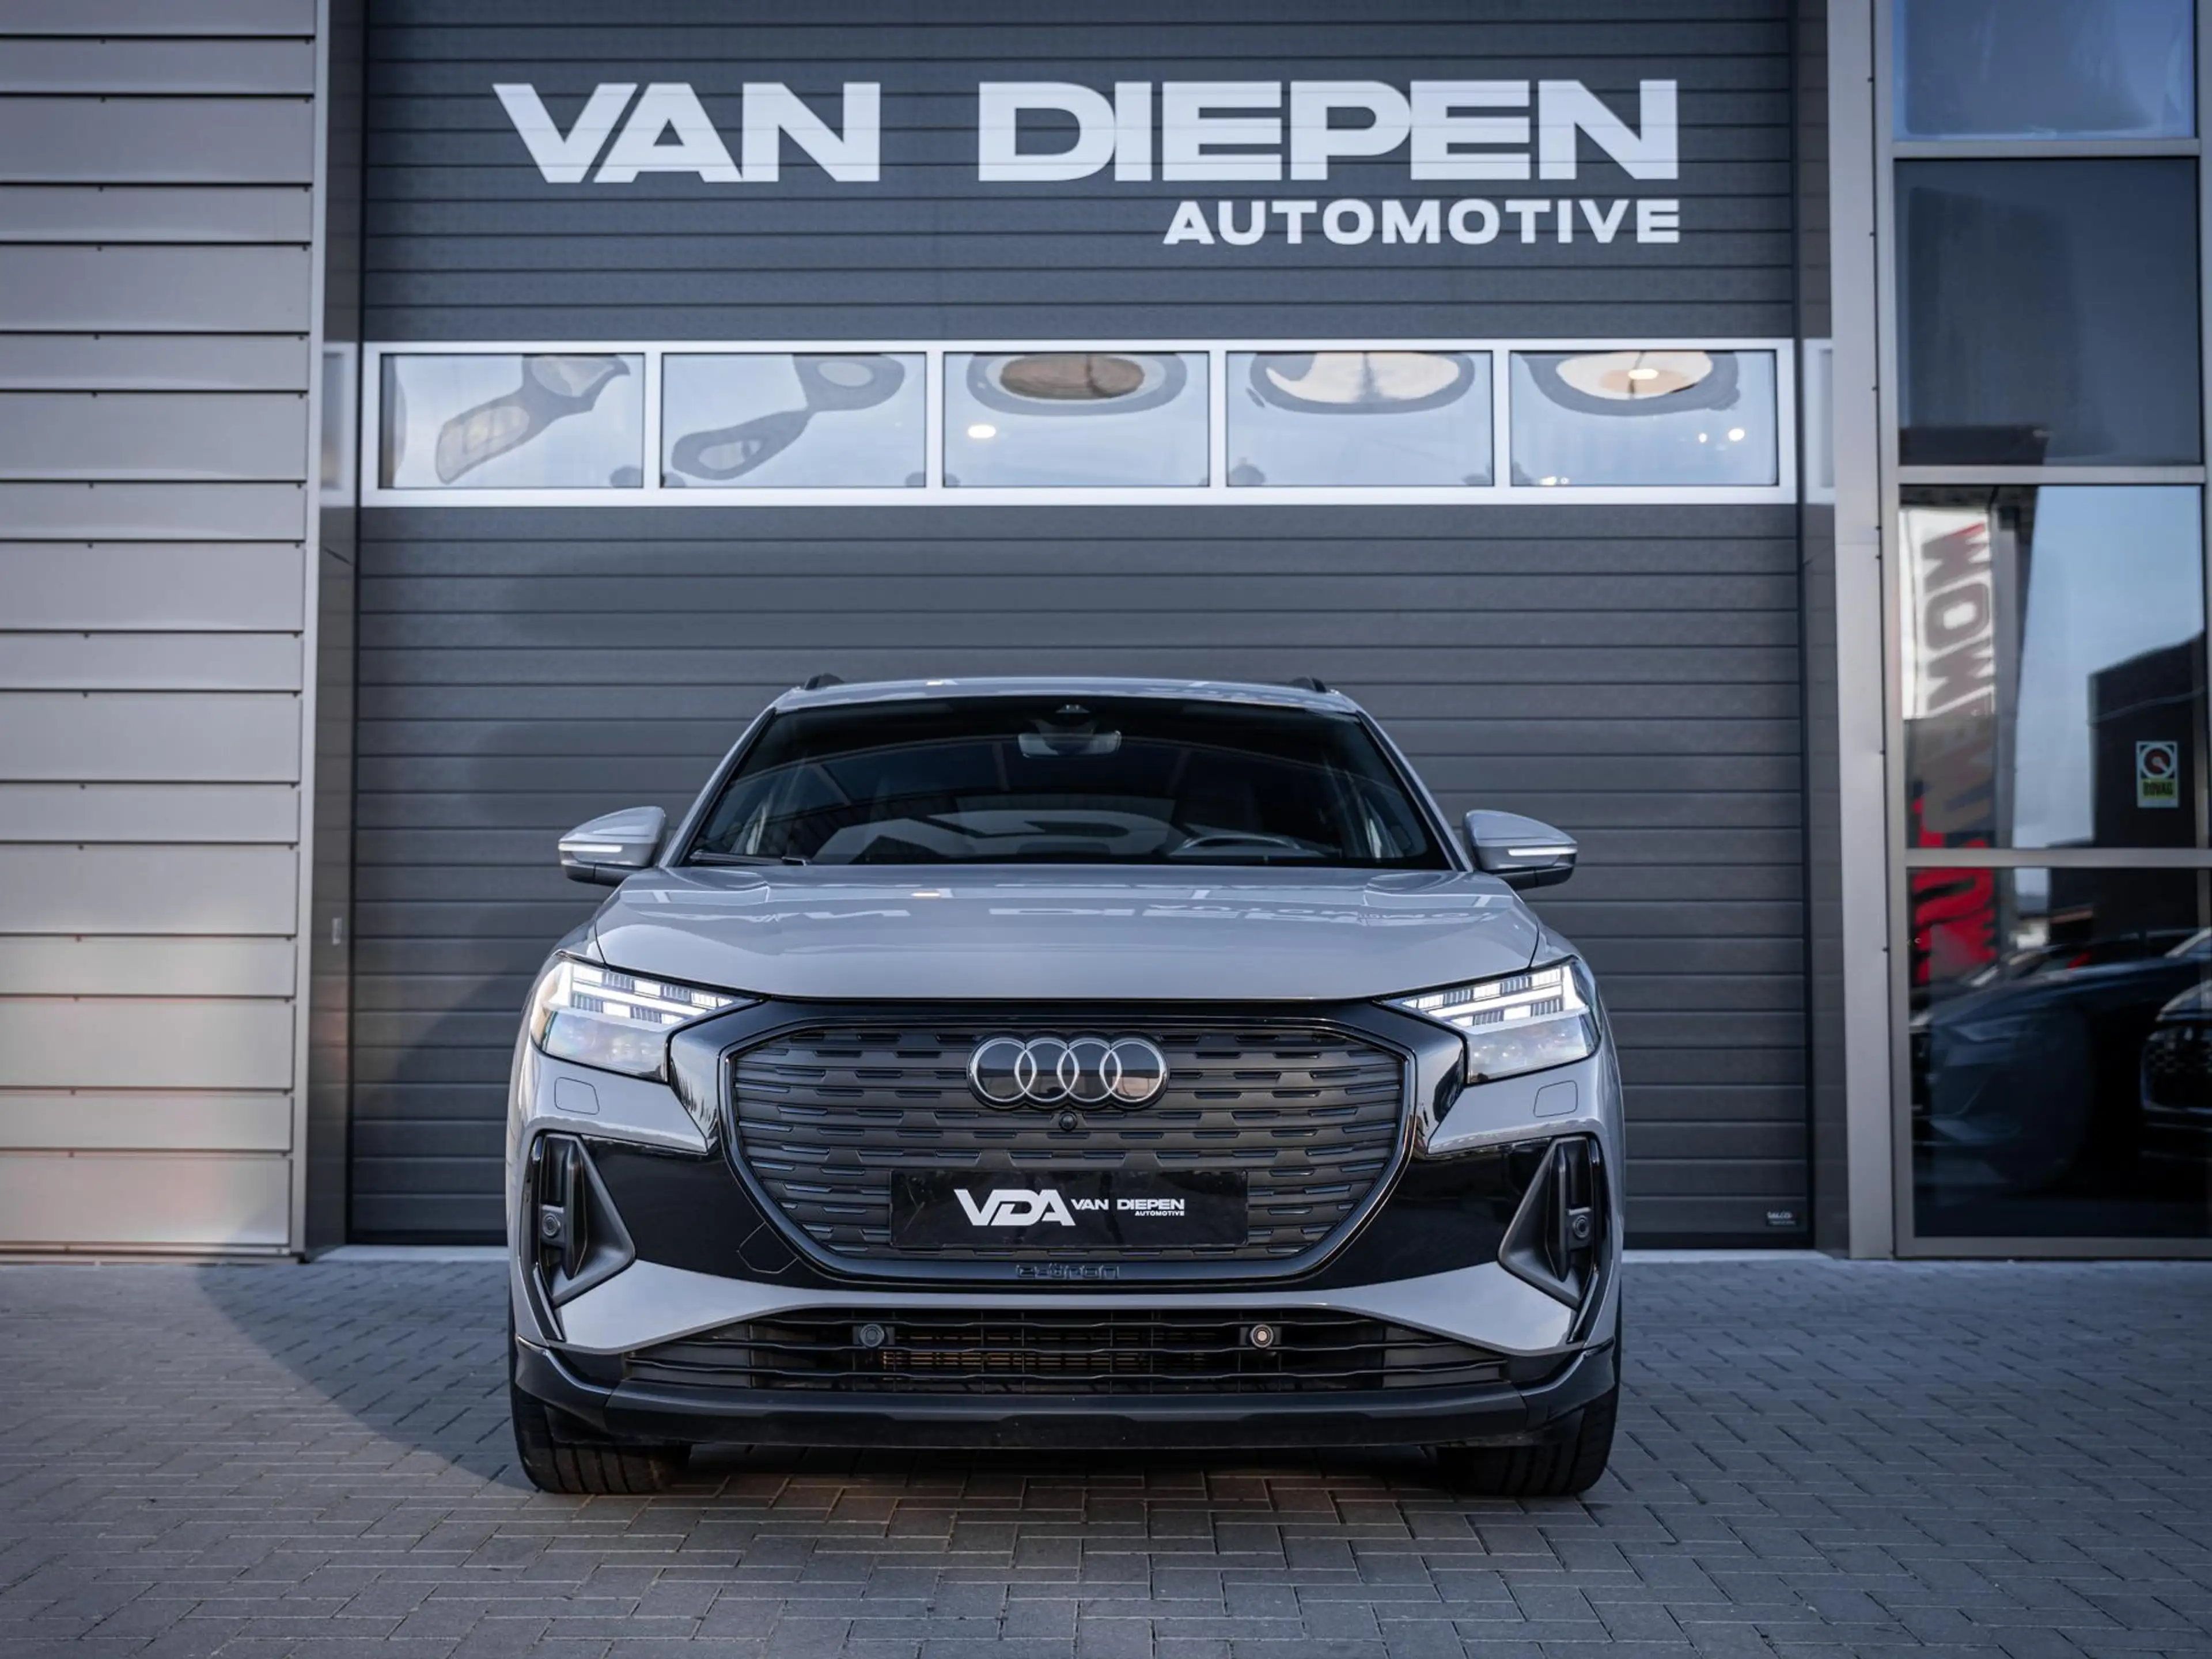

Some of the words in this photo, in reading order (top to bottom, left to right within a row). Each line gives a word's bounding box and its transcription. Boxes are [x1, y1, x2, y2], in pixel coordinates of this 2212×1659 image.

[493, 82, 881, 183] VAN
[978, 79, 1678, 181] DIEPEN
[1162, 199, 1680, 246] AUTOMOTIVE
[953, 1188, 1076, 1226] VDA
[1071, 1198, 1109, 1210] VAN
[1116, 1198, 1185, 1210] DIEPEN
